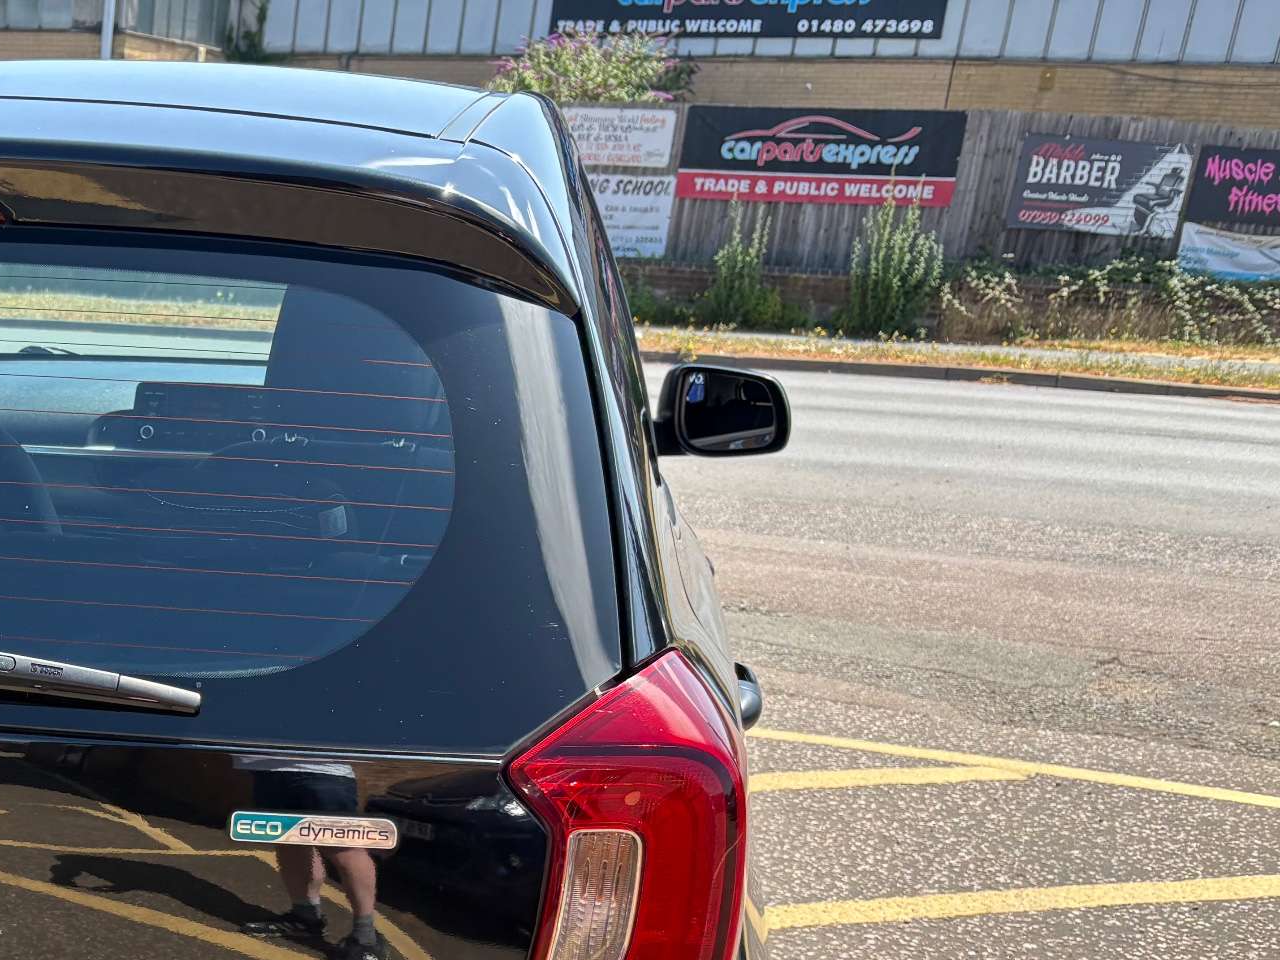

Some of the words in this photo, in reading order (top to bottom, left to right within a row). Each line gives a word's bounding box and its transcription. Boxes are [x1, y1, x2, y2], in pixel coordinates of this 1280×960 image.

[556, 19, 604, 33] TRADE
[627, 19, 681, 33] PUBLIC
[684, 19, 762, 34] WELCOME
[796, 19, 856, 34] 01480
[860, 19, 934, 34] 473698
[720, 138, 920, 170] carpartsexpress
[1026, 155, 1121, 189] BARBER
[1204, 154, 1276, 186] Muscle
[612, 178, 672, 197] SCHOOL
[694, 177, 750, 193] TRADE
[754, 179, 768, 194] &
[773, 180, 839, 198] PUBLIC
[844, 182, 935, 199] WELCOME
[236, 819, 282, 836] ECO
[299, 822, 389, 841] dynamics
